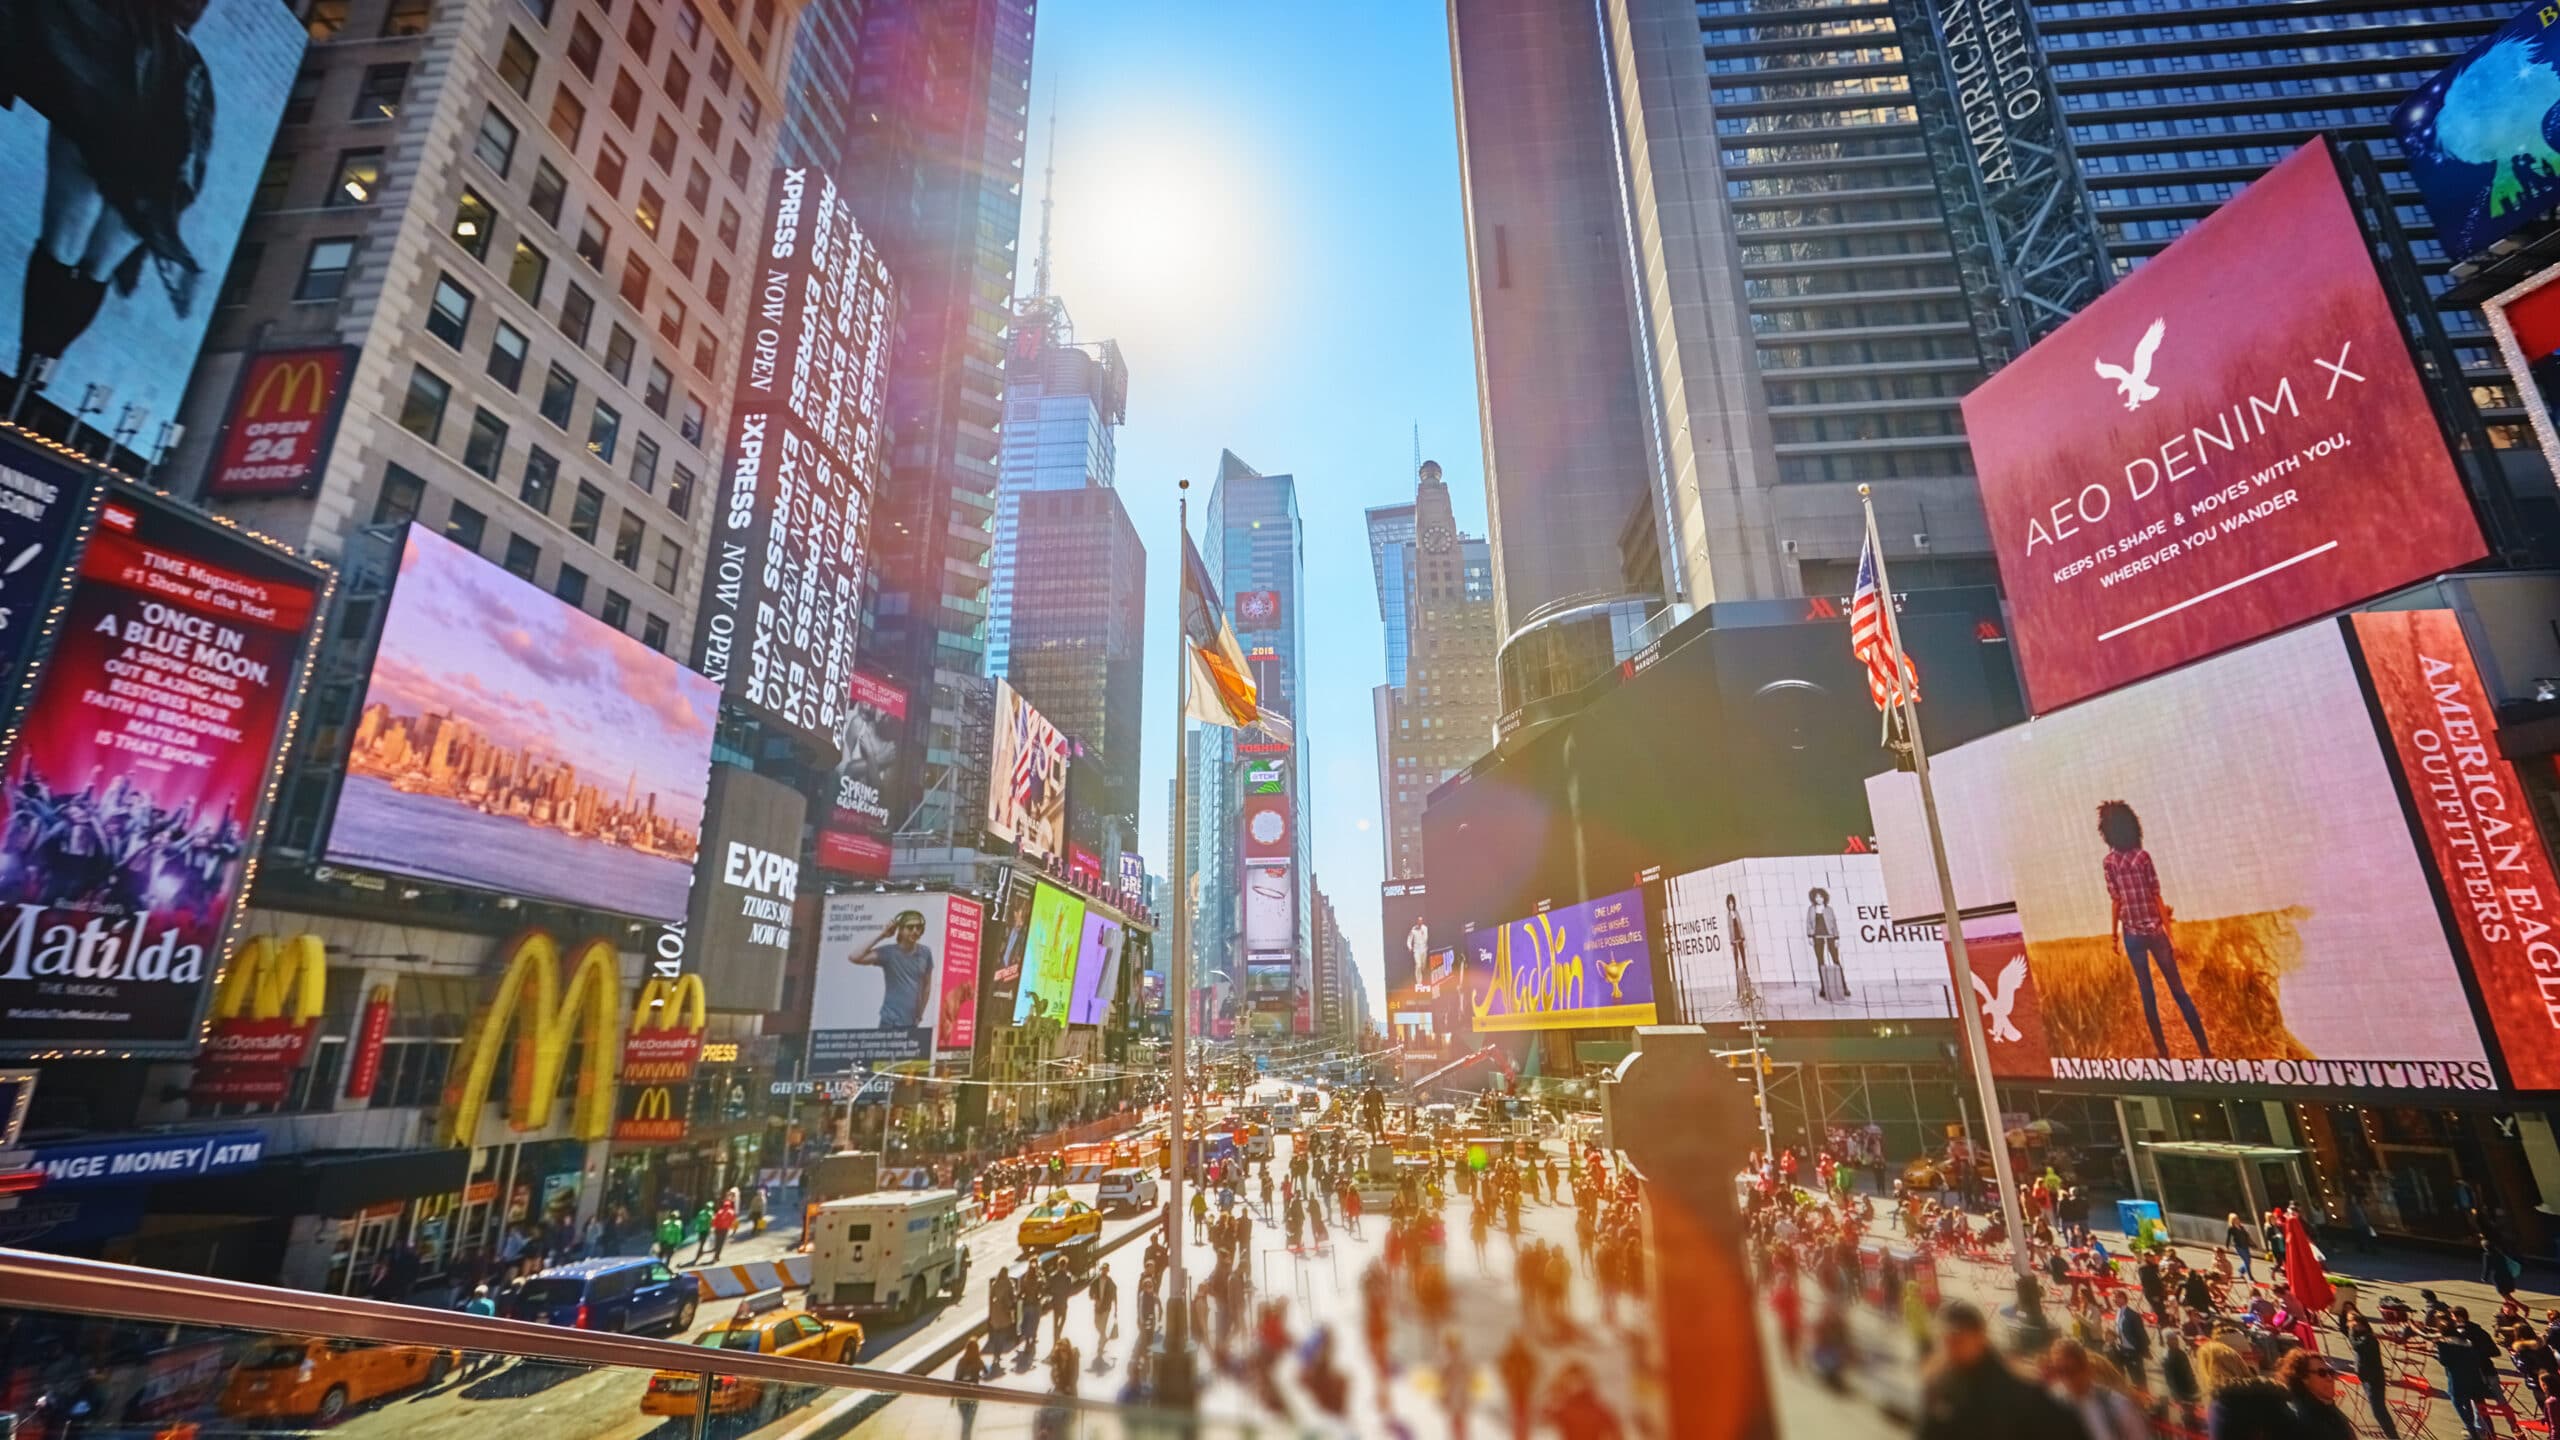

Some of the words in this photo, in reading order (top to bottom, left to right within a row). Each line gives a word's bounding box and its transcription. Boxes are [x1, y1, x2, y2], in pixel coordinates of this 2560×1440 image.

[761, 268, 789, 326] NOW
[750, 328, 780, 393] OPEN
[860, 287, 885, 418] EXPRESS
[244, 437, 296, 463] 24
[245, 419, 312, 438] OPEN
[2026, 484, 2111, 557] AEO
[2124, 376, 2300, 501] DENIM
[2313, 340, 2366, 400] X
[223, 464, 306, 482] HOURS
[763, 429, 799, 593] EXPRESS
[2053, 553, 2095, 584] KEEPS
[2095, 544, 2118, 566] ITS
[2118, 520, 2168, 557] SHAPE
[2173, 512, 2186, 527] &
[2191, 480, 2251, 518] MOVES
[2251, 454, 2301, 491] WITH
[2302, 431, 2352, 463] YOU,
[776, 549, 801, 645] OPEN
[790, 462, 811, 553] NOW
[2099, 541, 2182, 589] WHEREVER
[2182, 526, 2219, 552] YOU
[2219, 487, 2299, 536] WANDER
[121, 567, 144, 583] #1
[148, 572, 194, 598] Show
[194, 588, 211, 602] of
[212, 591, 236, 611] the
[142, 551, 186, 577] TIME
[187, 565, 269, 602] Magazine's
[714, 540, 746, 611] NOW
[794, 494, 827, 652] EXPRESS
[94, 613, 118, 637] A
[123, 620, 191, 659] BLUE
[215, 626, 245, 652] IN
[819, 573, 850, 728] EXPRESS
[104, 659, 143, 680] OUT
[142, 670, 211, 700] BLAZING
[209, 691, 244, 710] AND
[121, 647, 136, 660] A
[137, 652, 188, 674] SHOW
[187, 665, 238, 692] COMES
[82, 689, 136, 714] FAITH
[135, 703, 156, 719] IN
[110, 678, 188, 711] RESTORES
[190, 700, 231, 723] YOUR
[95, 730, 114, 745] IS
[114, 733, 161, 756] THAT
[124, 719, 199, 749] MATILDA
[1238, 743, 1290, 753] TOSHIBA
[2418, 653, 2529, 874] AMERICAN
[836, 796, 890, 827] awakening
[840, 775, 879, 804] SPRING
[2412, 728, 2511, 944] OUTFITTERS
[741, 894, 780, 921] TIMES
[1701, 916, 1718, 932] THE
[748, 922, 777, 946] NOW
[1705, 934, 1721, 953] DO
[1471, 913, 1585, 1017] Aladdin
[627, 1038, 698, 1051] McDonald's
[699, 1043, 739, 1062] PRESS
[2054, 1057, 2173, 1082] AMERICAN
[2184, 1060, 2267, 1084] EAGLE
[2274, 1060, 2494, 1090] OUTFITTERS
[109, 1147, 204, 1176] MONEY
[211, 1142, 262, 1166] ATM
